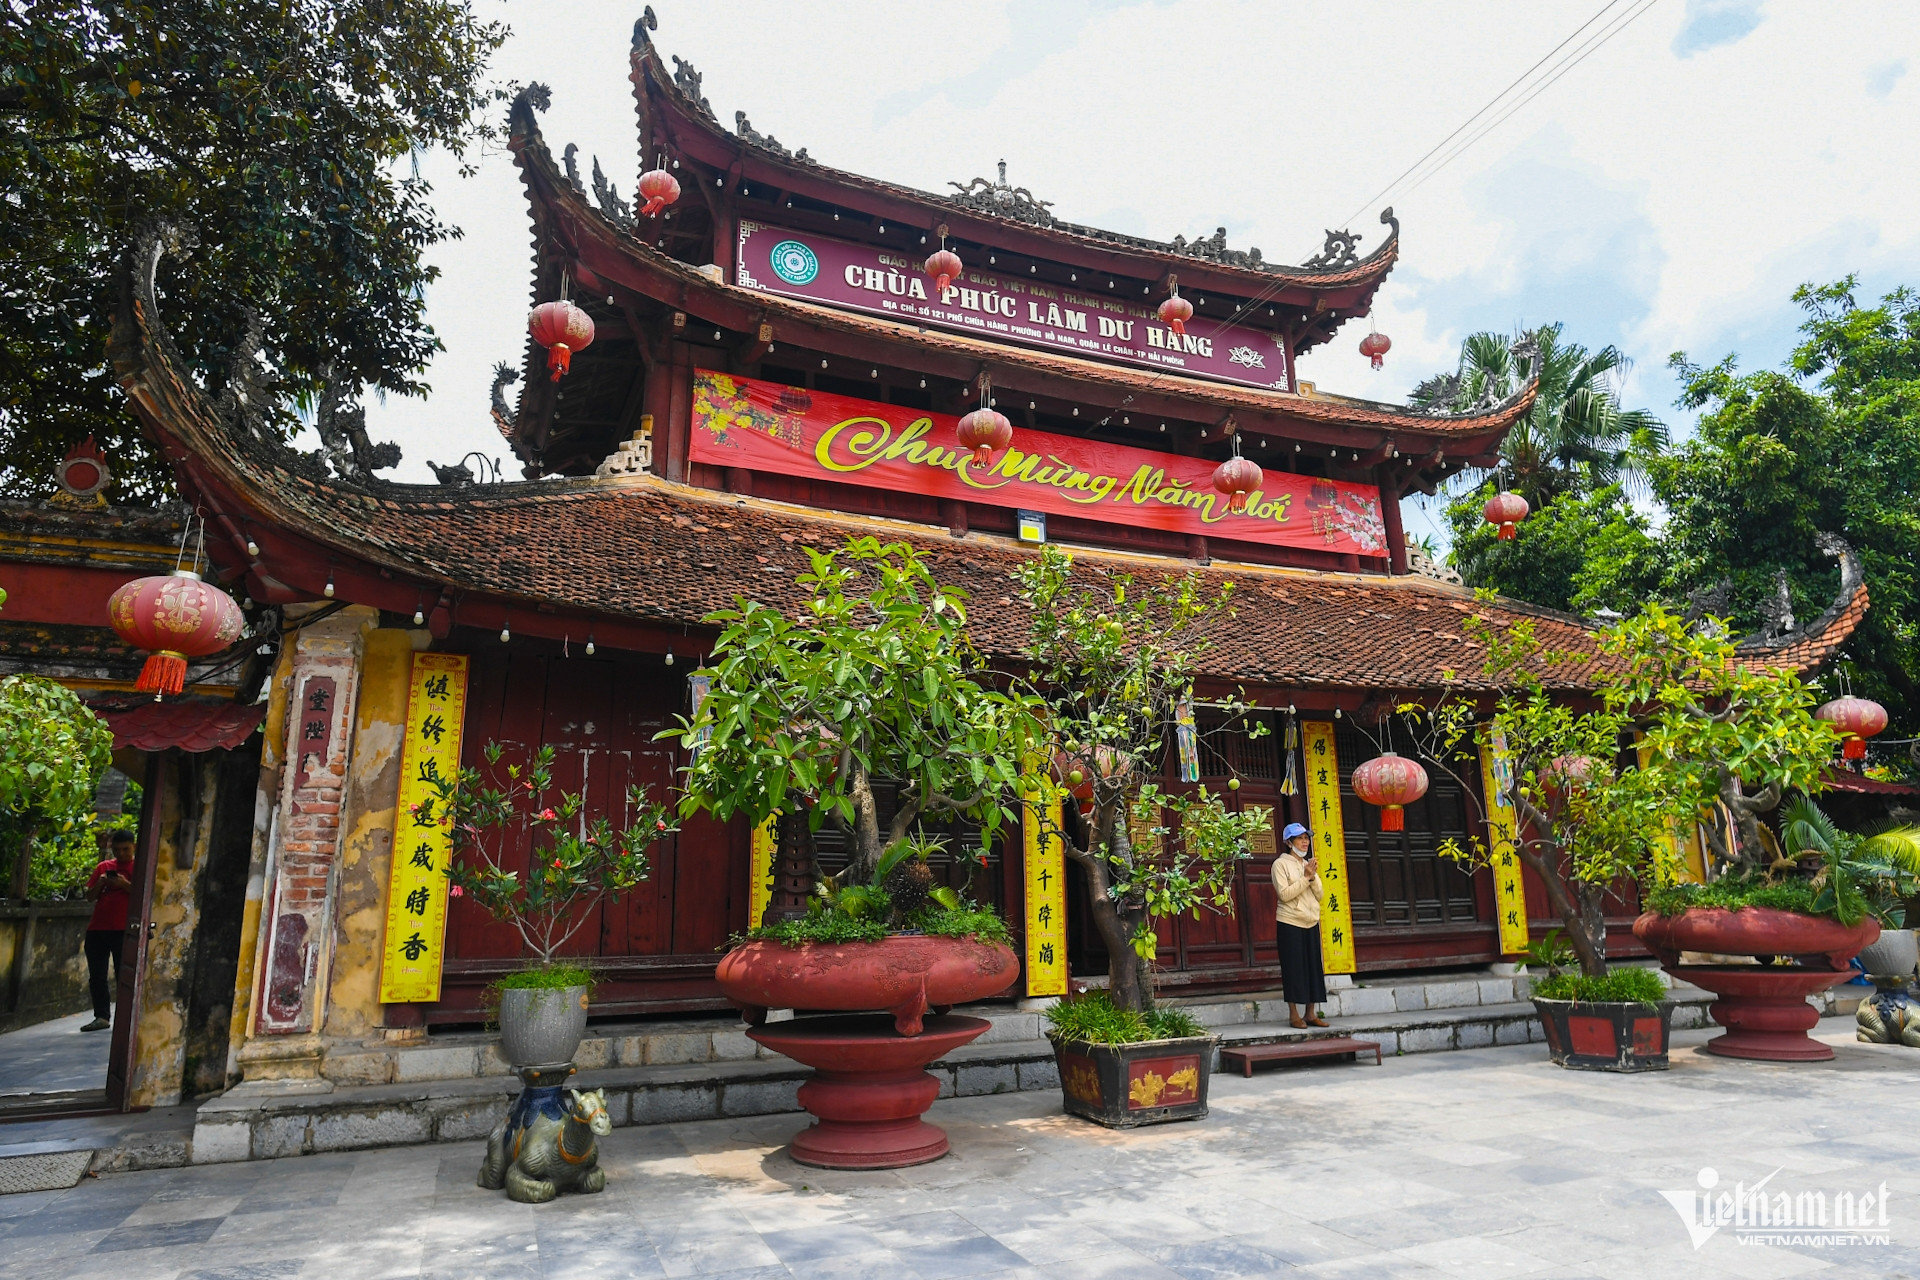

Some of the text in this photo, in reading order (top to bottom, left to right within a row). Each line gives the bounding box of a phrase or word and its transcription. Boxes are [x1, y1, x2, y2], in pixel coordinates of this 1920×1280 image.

[844, 264, 1214, 358] CHÙA PHÚC LÂM DƯ HÀNG
[878, 254, 908, 269] GIÁO
[969, 272, 998, 287] GIÁO
[1002, 280, 1027, 293] VIỆT
[1030, 286, 1059, 300] NAM
[882, 300, 898, 311] ĐỊA
[918, 306, 930, 316] SỐ
[932, 309, 945, 320] 121
[946, 312, 963, 323] PHỐ
[987, 320, 1009, 332] HÀNG
[1079, 339, 1100, 351] QUẬN
[1102, 343, 1112, 353] LÊ
[1148, 351, 1161, 362] HẢI
[1162, 355, 1185, 366] PHÒNG
[987, 446, 1118, 504] Mừng
[1114, 464, 1229, 523] Năm
